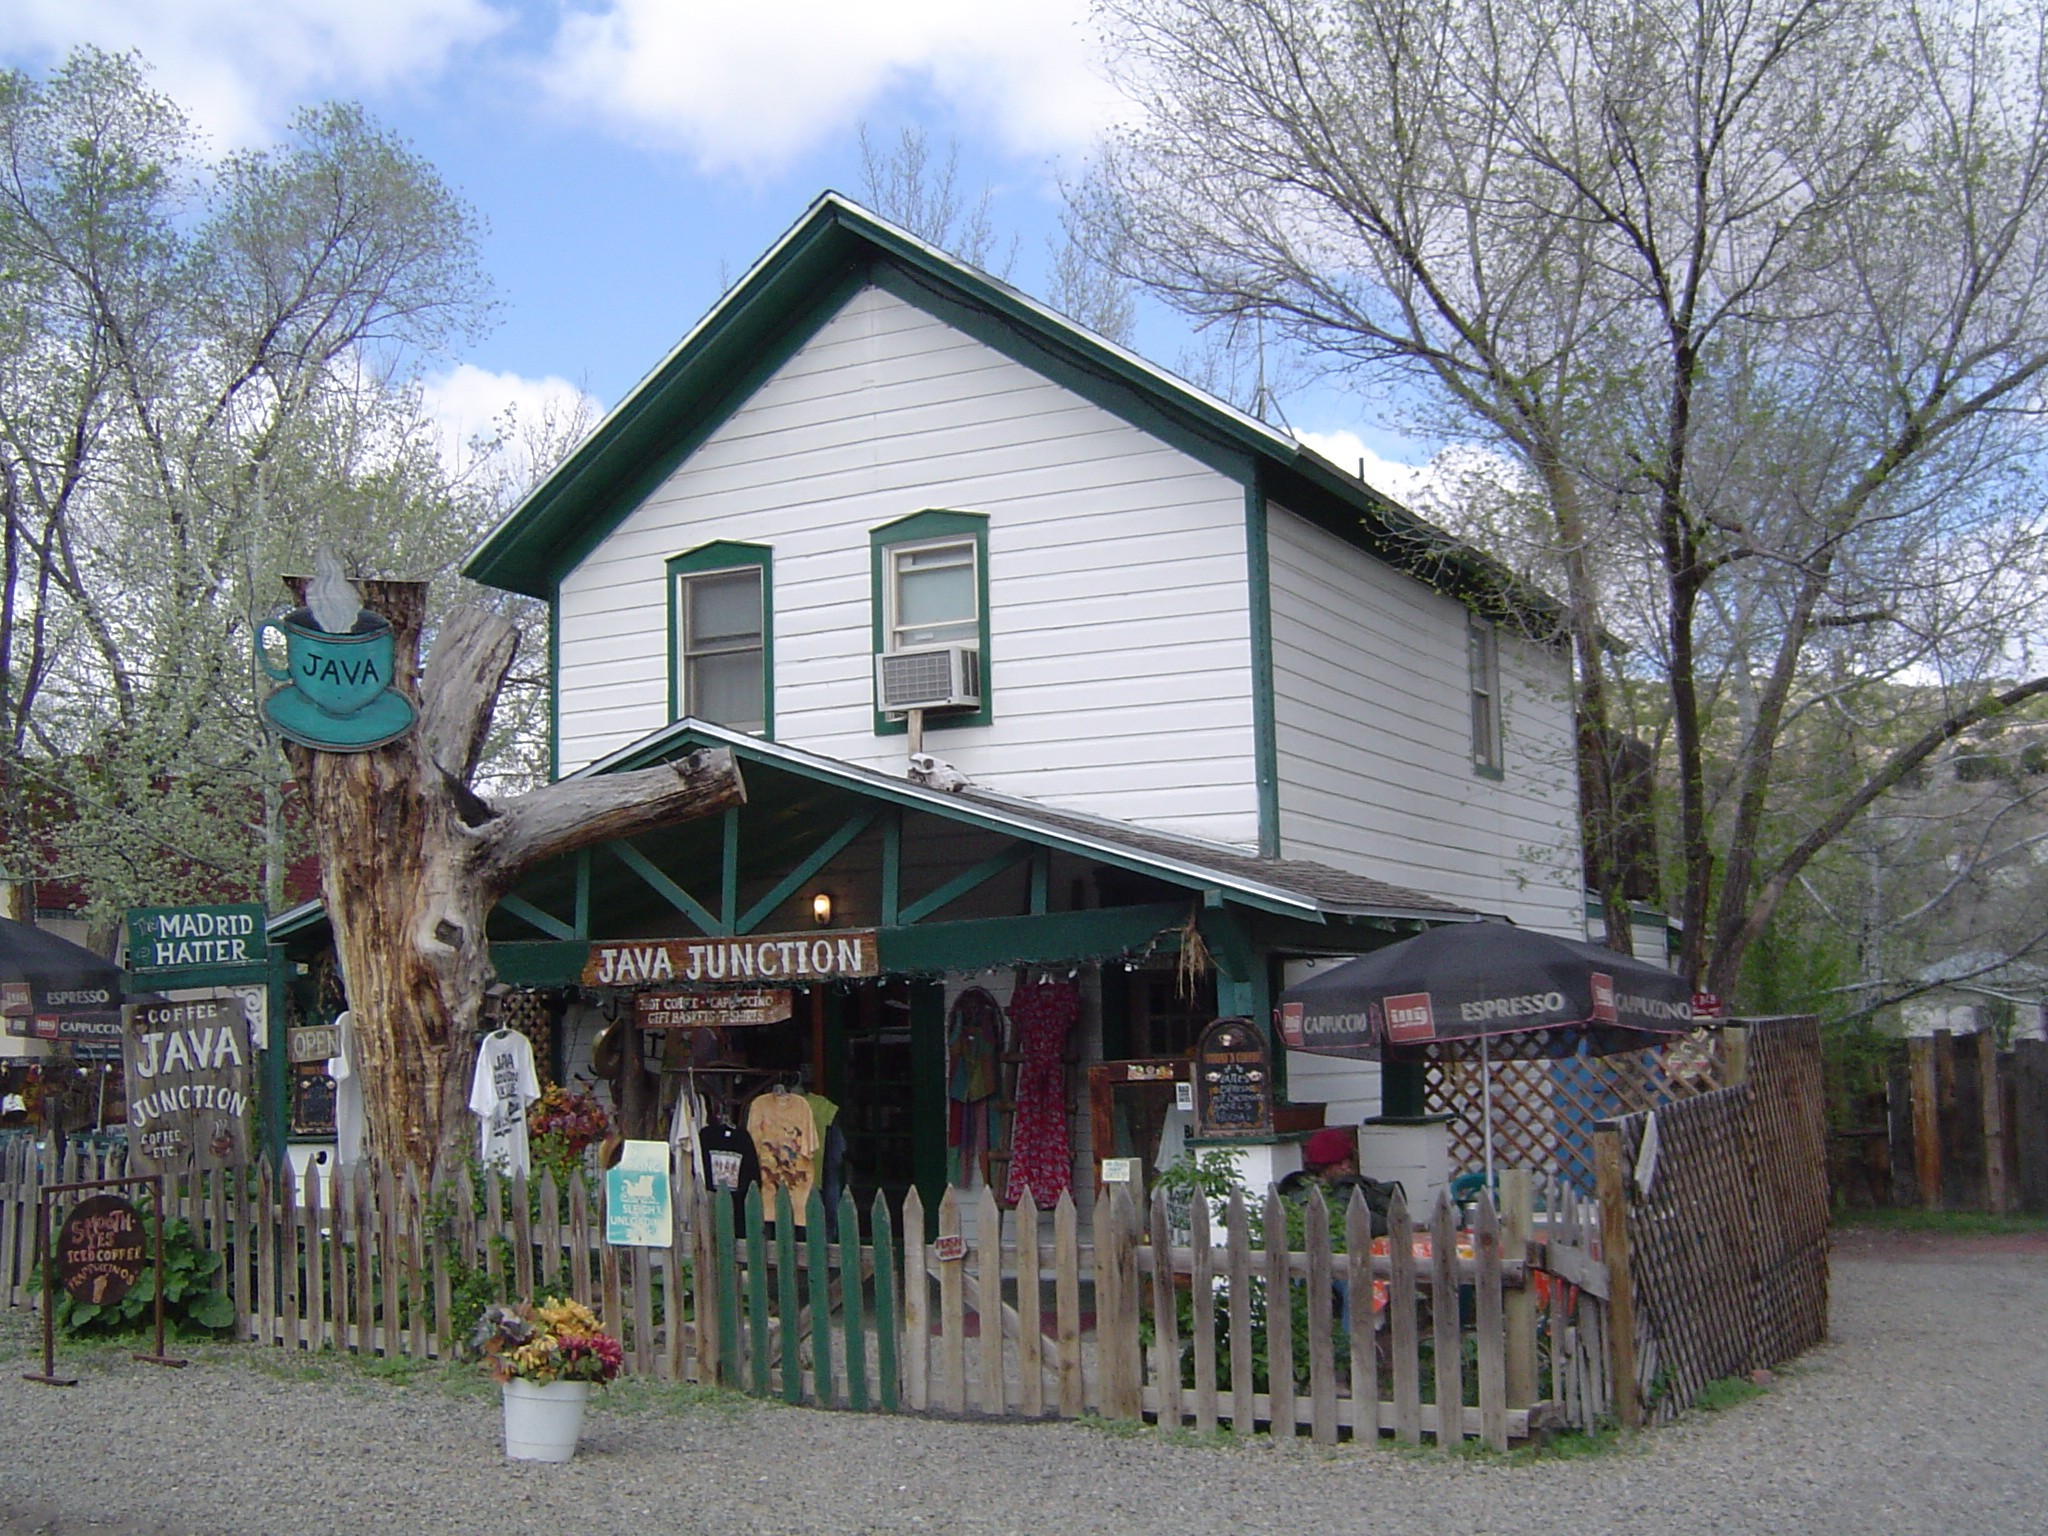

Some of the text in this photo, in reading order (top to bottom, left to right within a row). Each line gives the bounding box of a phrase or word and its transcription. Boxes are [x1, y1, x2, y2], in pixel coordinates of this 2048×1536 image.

[303, 653, 379, 686] JAVA
[158, 913, 253, 939] MADRID
[155, 939, 250, 965] HATTER
[598, 939, 863, 983] JAVA JUNCTION
[47, 989, 110, 1006] ESPRESSO
[1460, 992, 1565, 1022] ESPRESSO
[147, 1004, 218, 1024] COFFEE
[648, 1011, 670, 1024] GIFT
[137, 1025, 243, 1078] JAVA
[294, 1031, 339, 1057] OPEN
[131, 1085, 247, 1128] JUNCTION
[141, 1129, 181, 1144] COFFEE
[153, 1146, 178, 1159] ETC.
[96, 1246, 142, 1262] COFFEE
